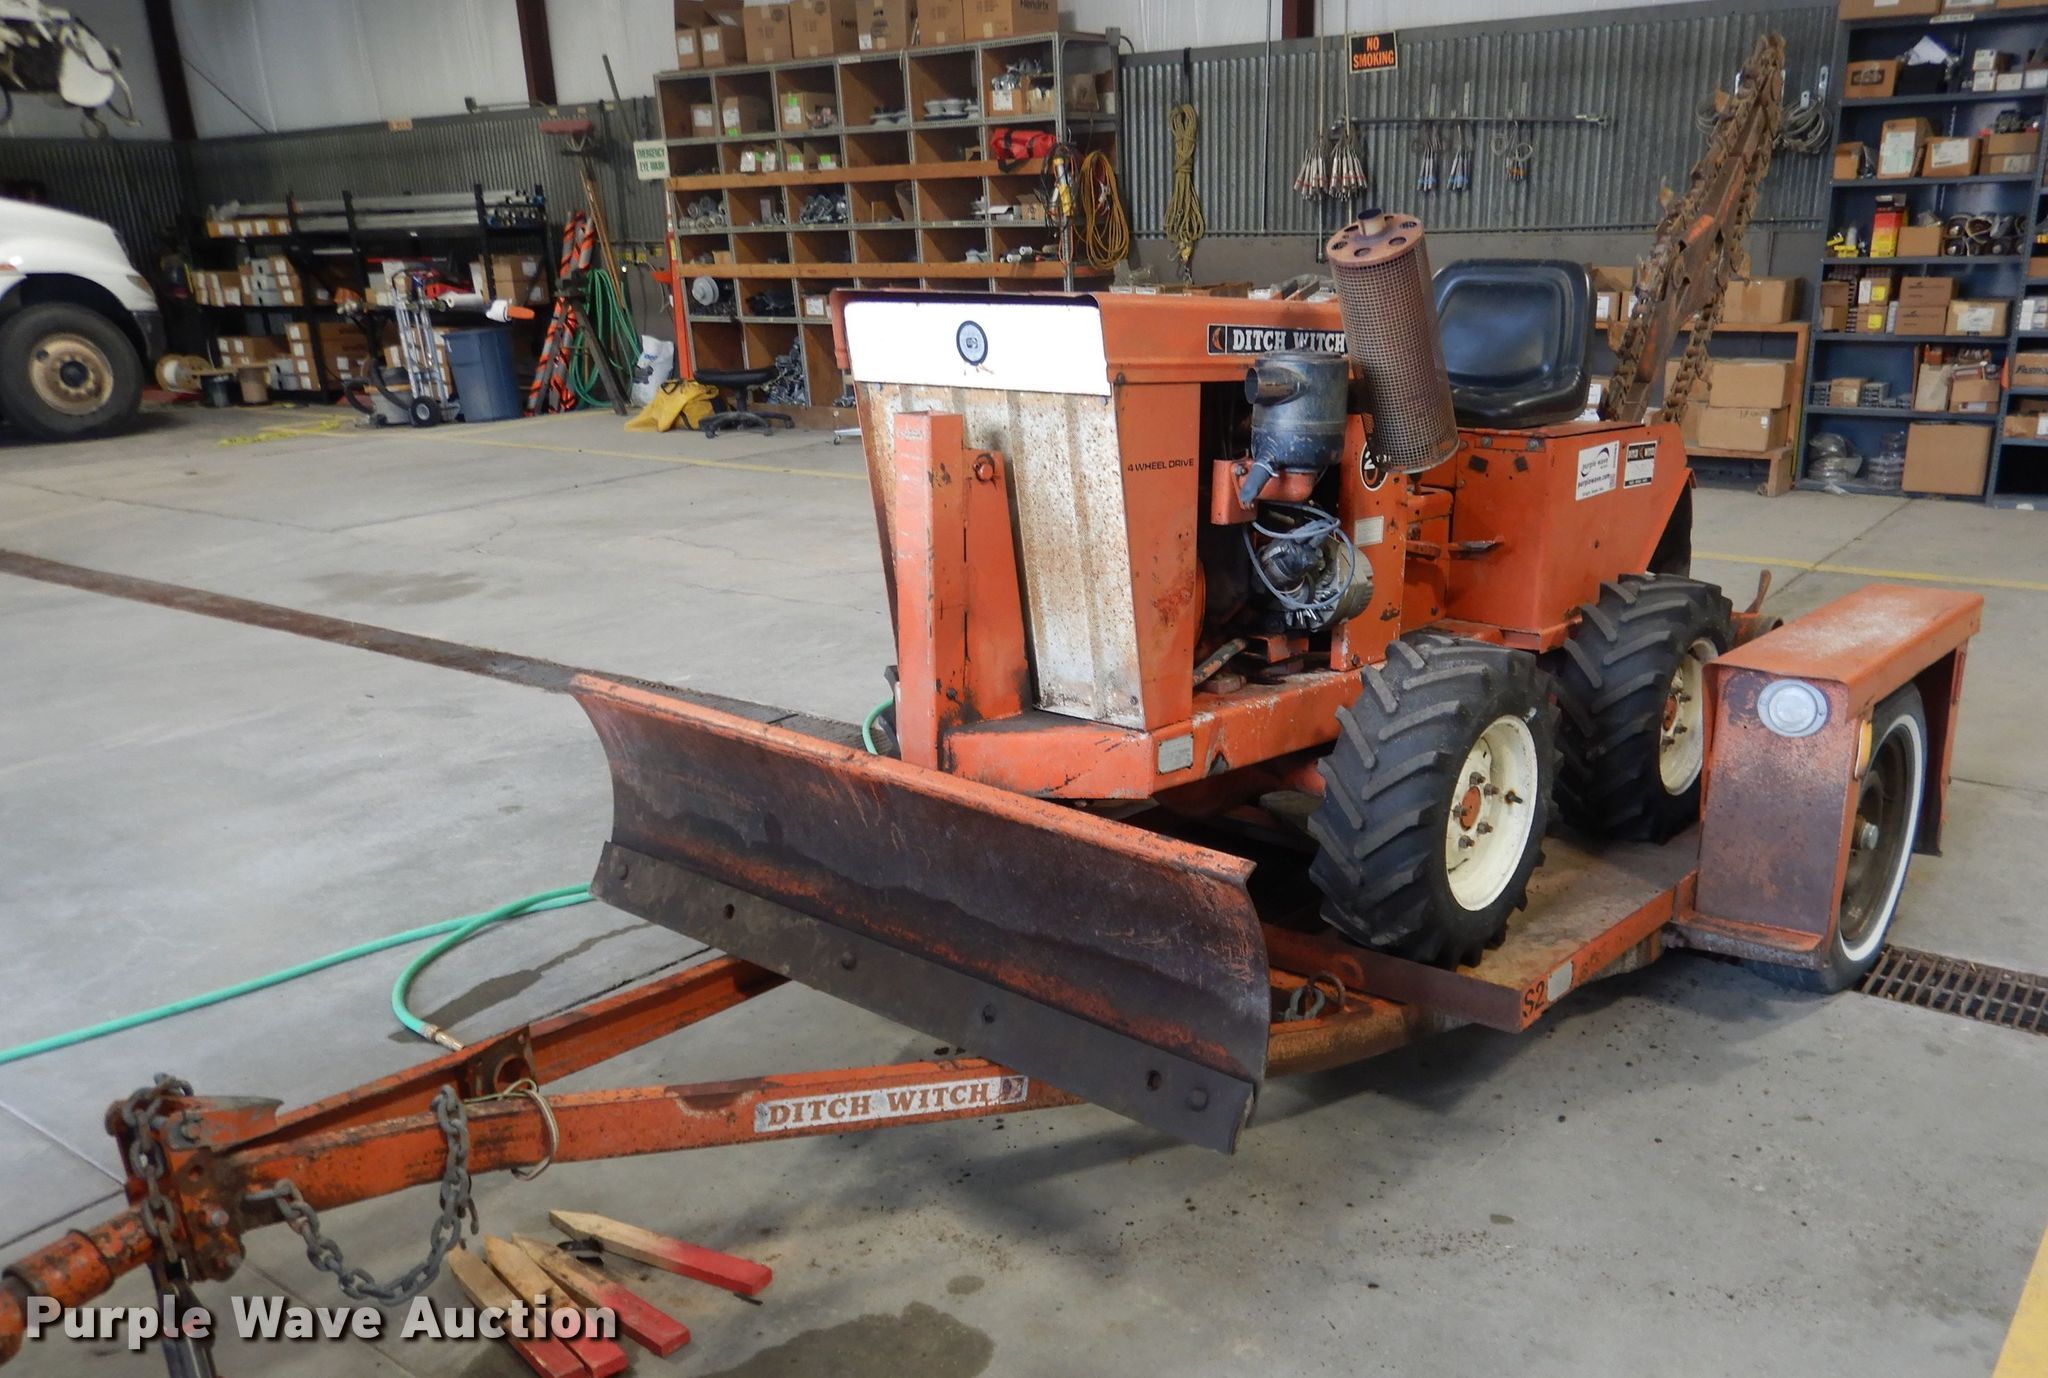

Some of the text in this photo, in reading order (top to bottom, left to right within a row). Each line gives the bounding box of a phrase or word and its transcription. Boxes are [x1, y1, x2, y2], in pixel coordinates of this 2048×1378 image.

[1366, 36, 1380, 51] NO
[1353, 50, 1394, 69] SMOKING
[636, 147, 665, 159] EMERGENCY
[640, 161, 649, 172] EYE
[1232, 328, 1346, 353] DITCH WITCH
[1127, 458, 1194, 471] 4 WHEEL DRIVE
[1582, 461, 1597, 470] purple
[767, 1083, 992, 1127] DITCH WITCH
